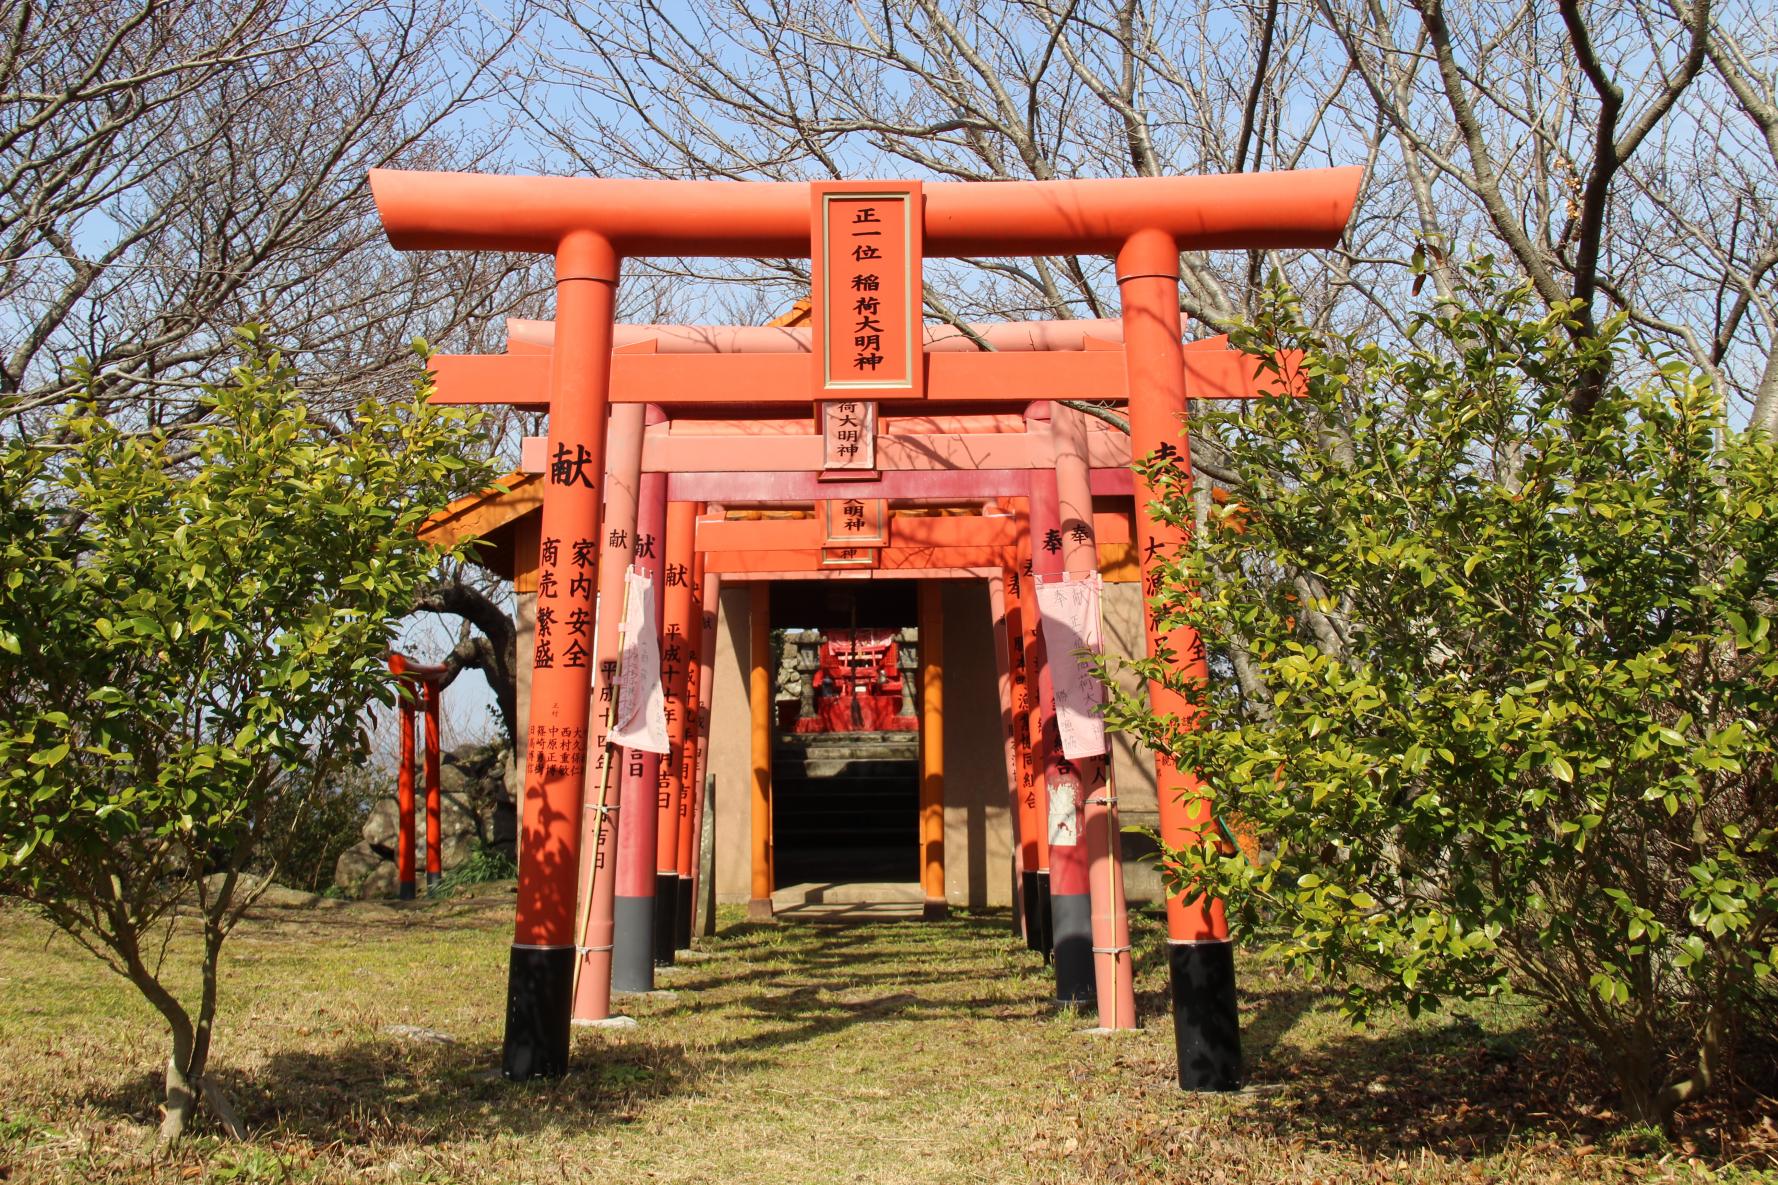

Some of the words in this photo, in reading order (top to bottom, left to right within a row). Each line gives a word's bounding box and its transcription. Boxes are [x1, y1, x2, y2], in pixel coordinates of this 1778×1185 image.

[851, 207, 884, 371] 正一位稲荷大明神
[551, 441, 595, 489] 献
[609, 528, 627, 550] 献
[635, 533, 656, 559] 献
[1043, 528, 1063, 555] 奉
[1071, 523, 1089, 545] 奉
[665, 562, 689, 588] 献
[533, 536, 561, 669] 商売繁盛
[562, 537, 596, 669] 家内安全
